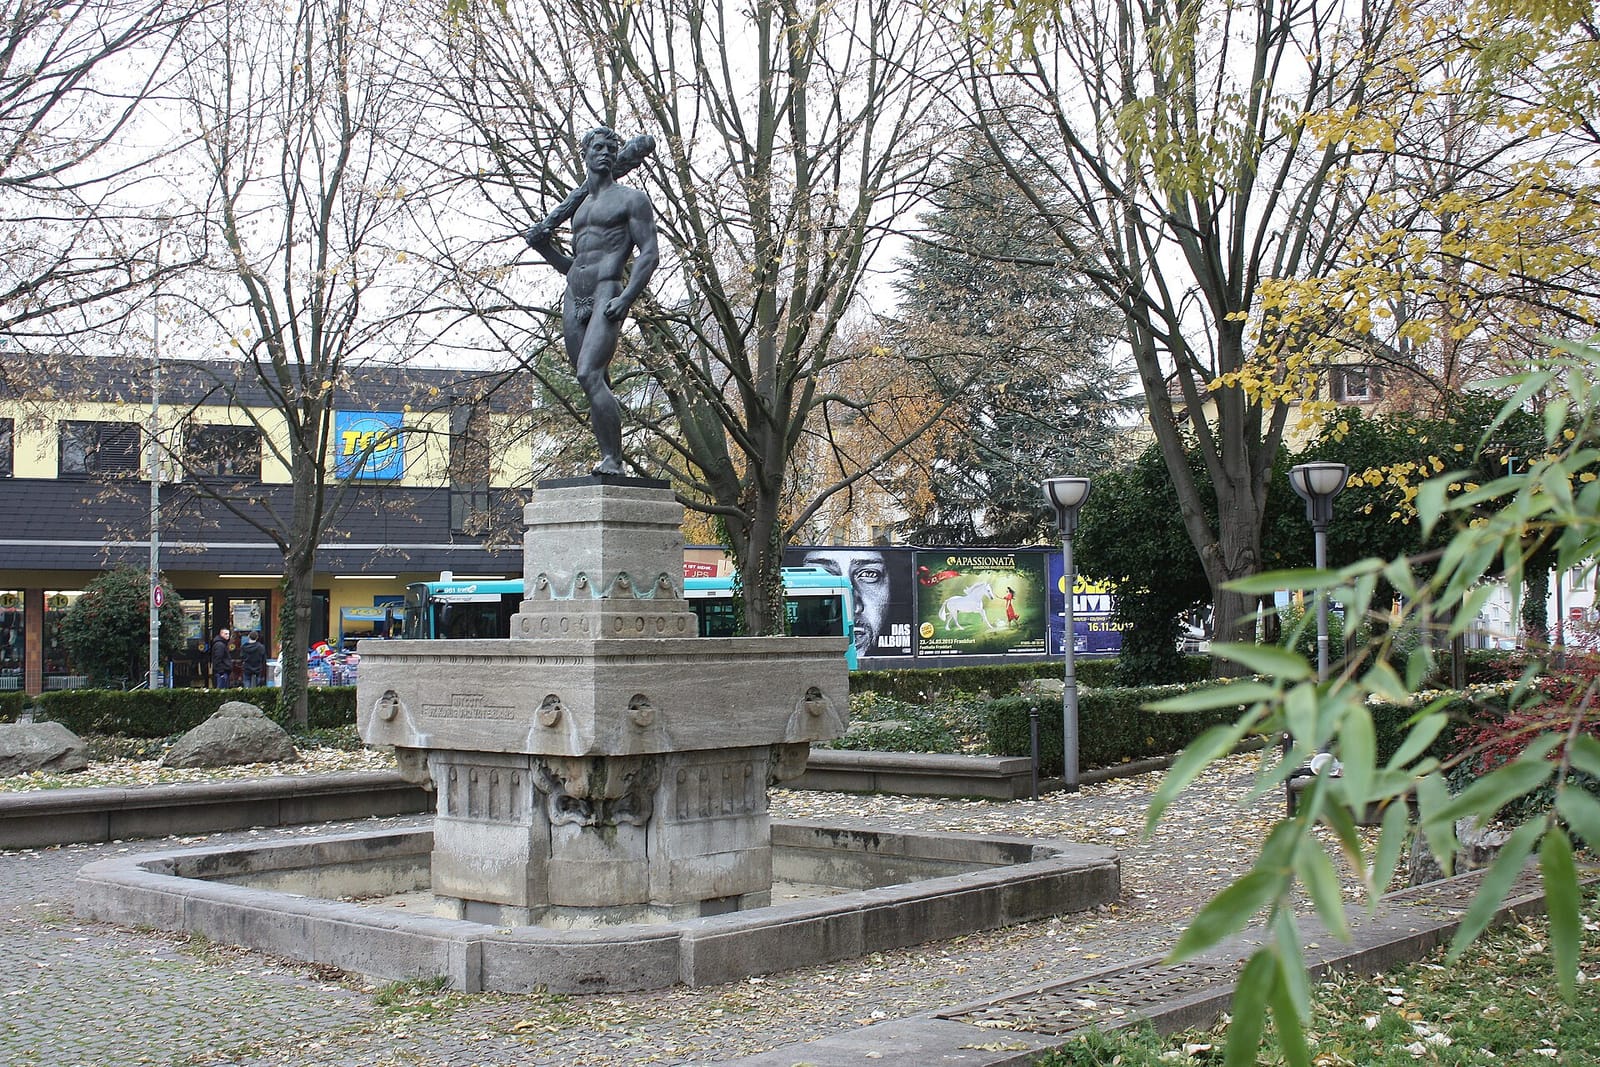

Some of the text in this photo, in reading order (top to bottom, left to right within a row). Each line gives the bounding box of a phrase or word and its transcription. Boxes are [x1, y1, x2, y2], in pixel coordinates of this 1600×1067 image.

[956, 556, 1015, 566] APASSIONATA
[891, 623, 911, 636] DAS
[878, 635, 911, 648] ALBUM
